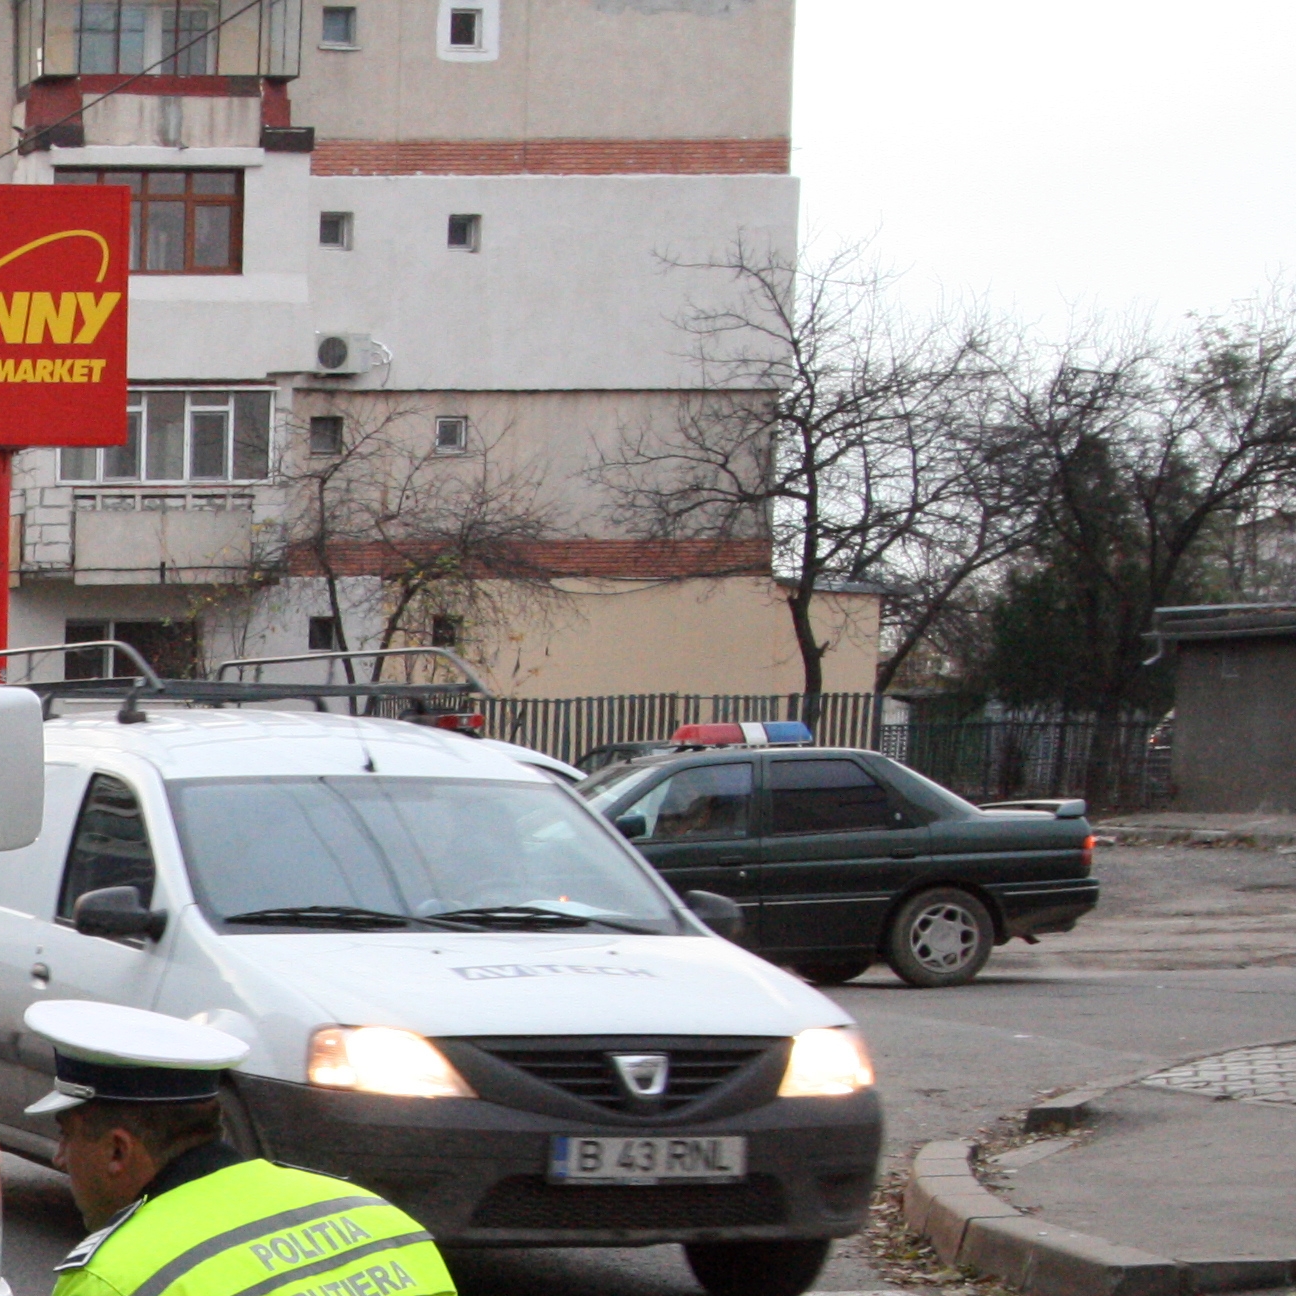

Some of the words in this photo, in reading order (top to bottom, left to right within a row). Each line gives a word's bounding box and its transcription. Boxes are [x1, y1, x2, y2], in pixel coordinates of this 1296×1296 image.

[578, 1140, 602, 1172] B
[616, 1140, 655, 1172] 43
[667, 1139, 731, 1172] RNL
[249, 1216, 372, 1272] POLITIA
